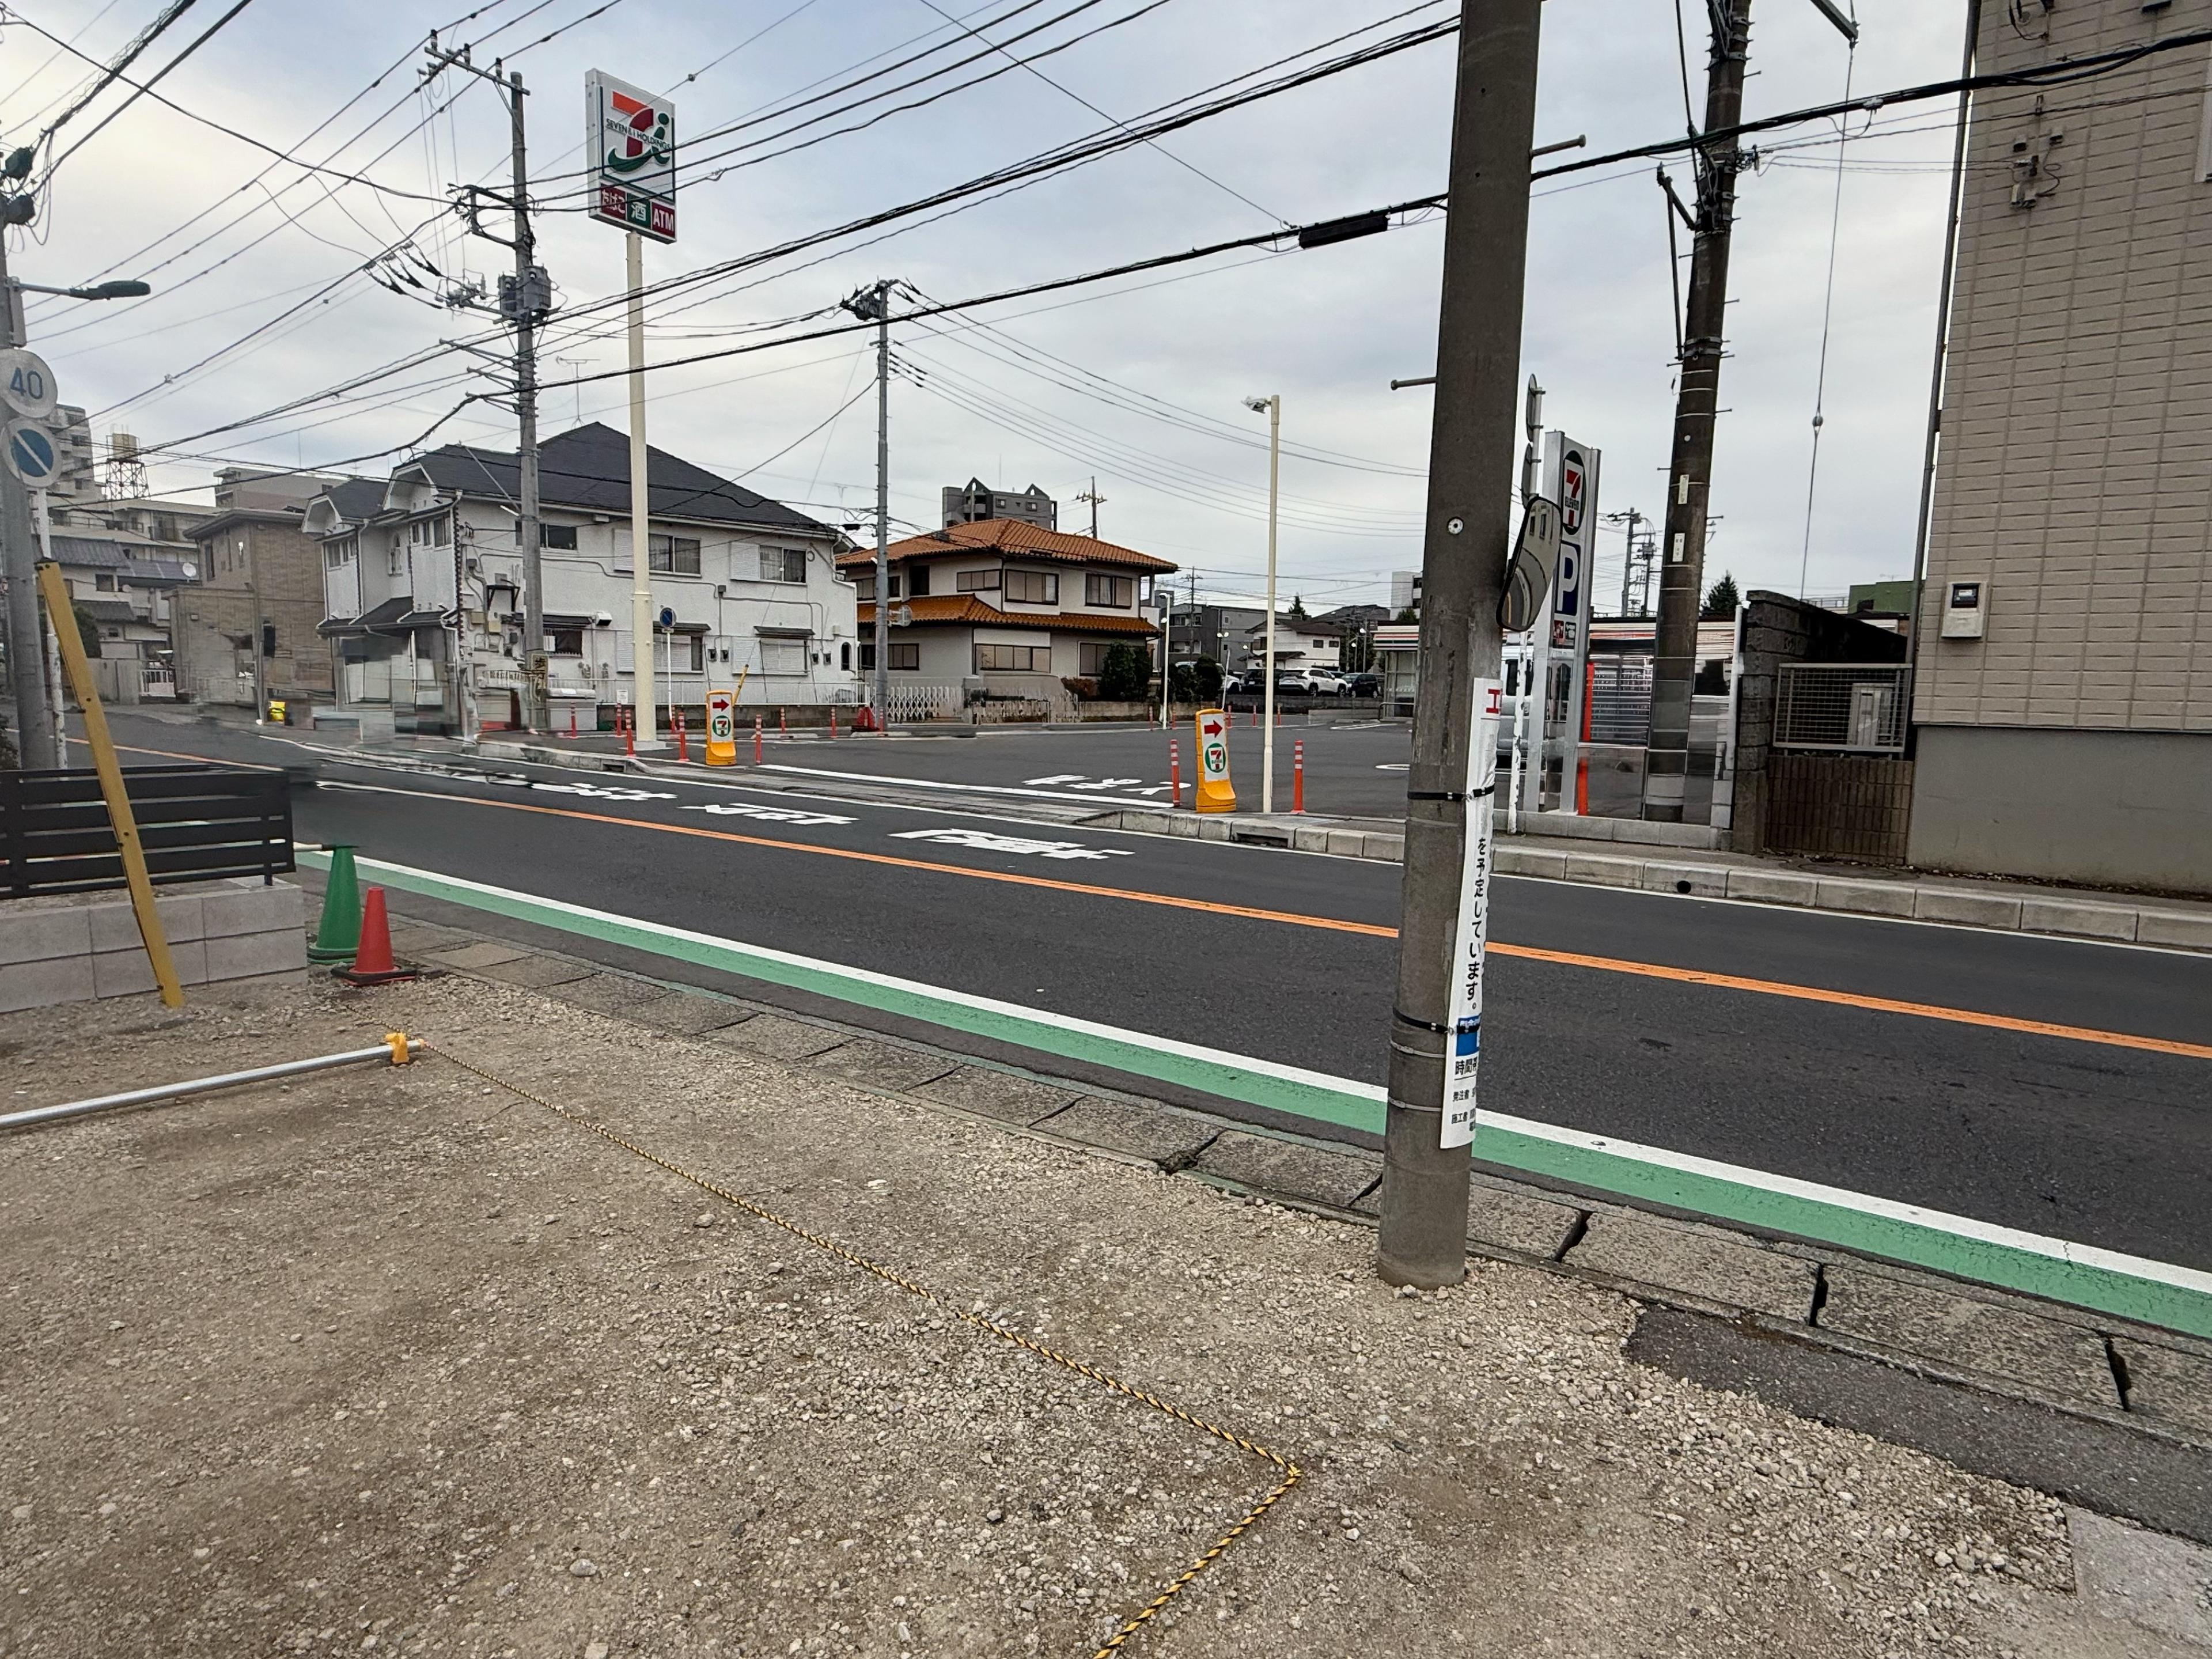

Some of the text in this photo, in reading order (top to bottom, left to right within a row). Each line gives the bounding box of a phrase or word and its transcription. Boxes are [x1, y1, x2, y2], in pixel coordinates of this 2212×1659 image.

[606, 118, 628, 134] SEVEN
[637, 132, 671, 150] HOLDINGS
[631, 202, 647, 222] 酒
[653, 208, 675, 232] ATM
[10, 366, 43, 399] 40
[1556, 543, 1578, 612] P
[1486, 688, 1502, 715] 工
